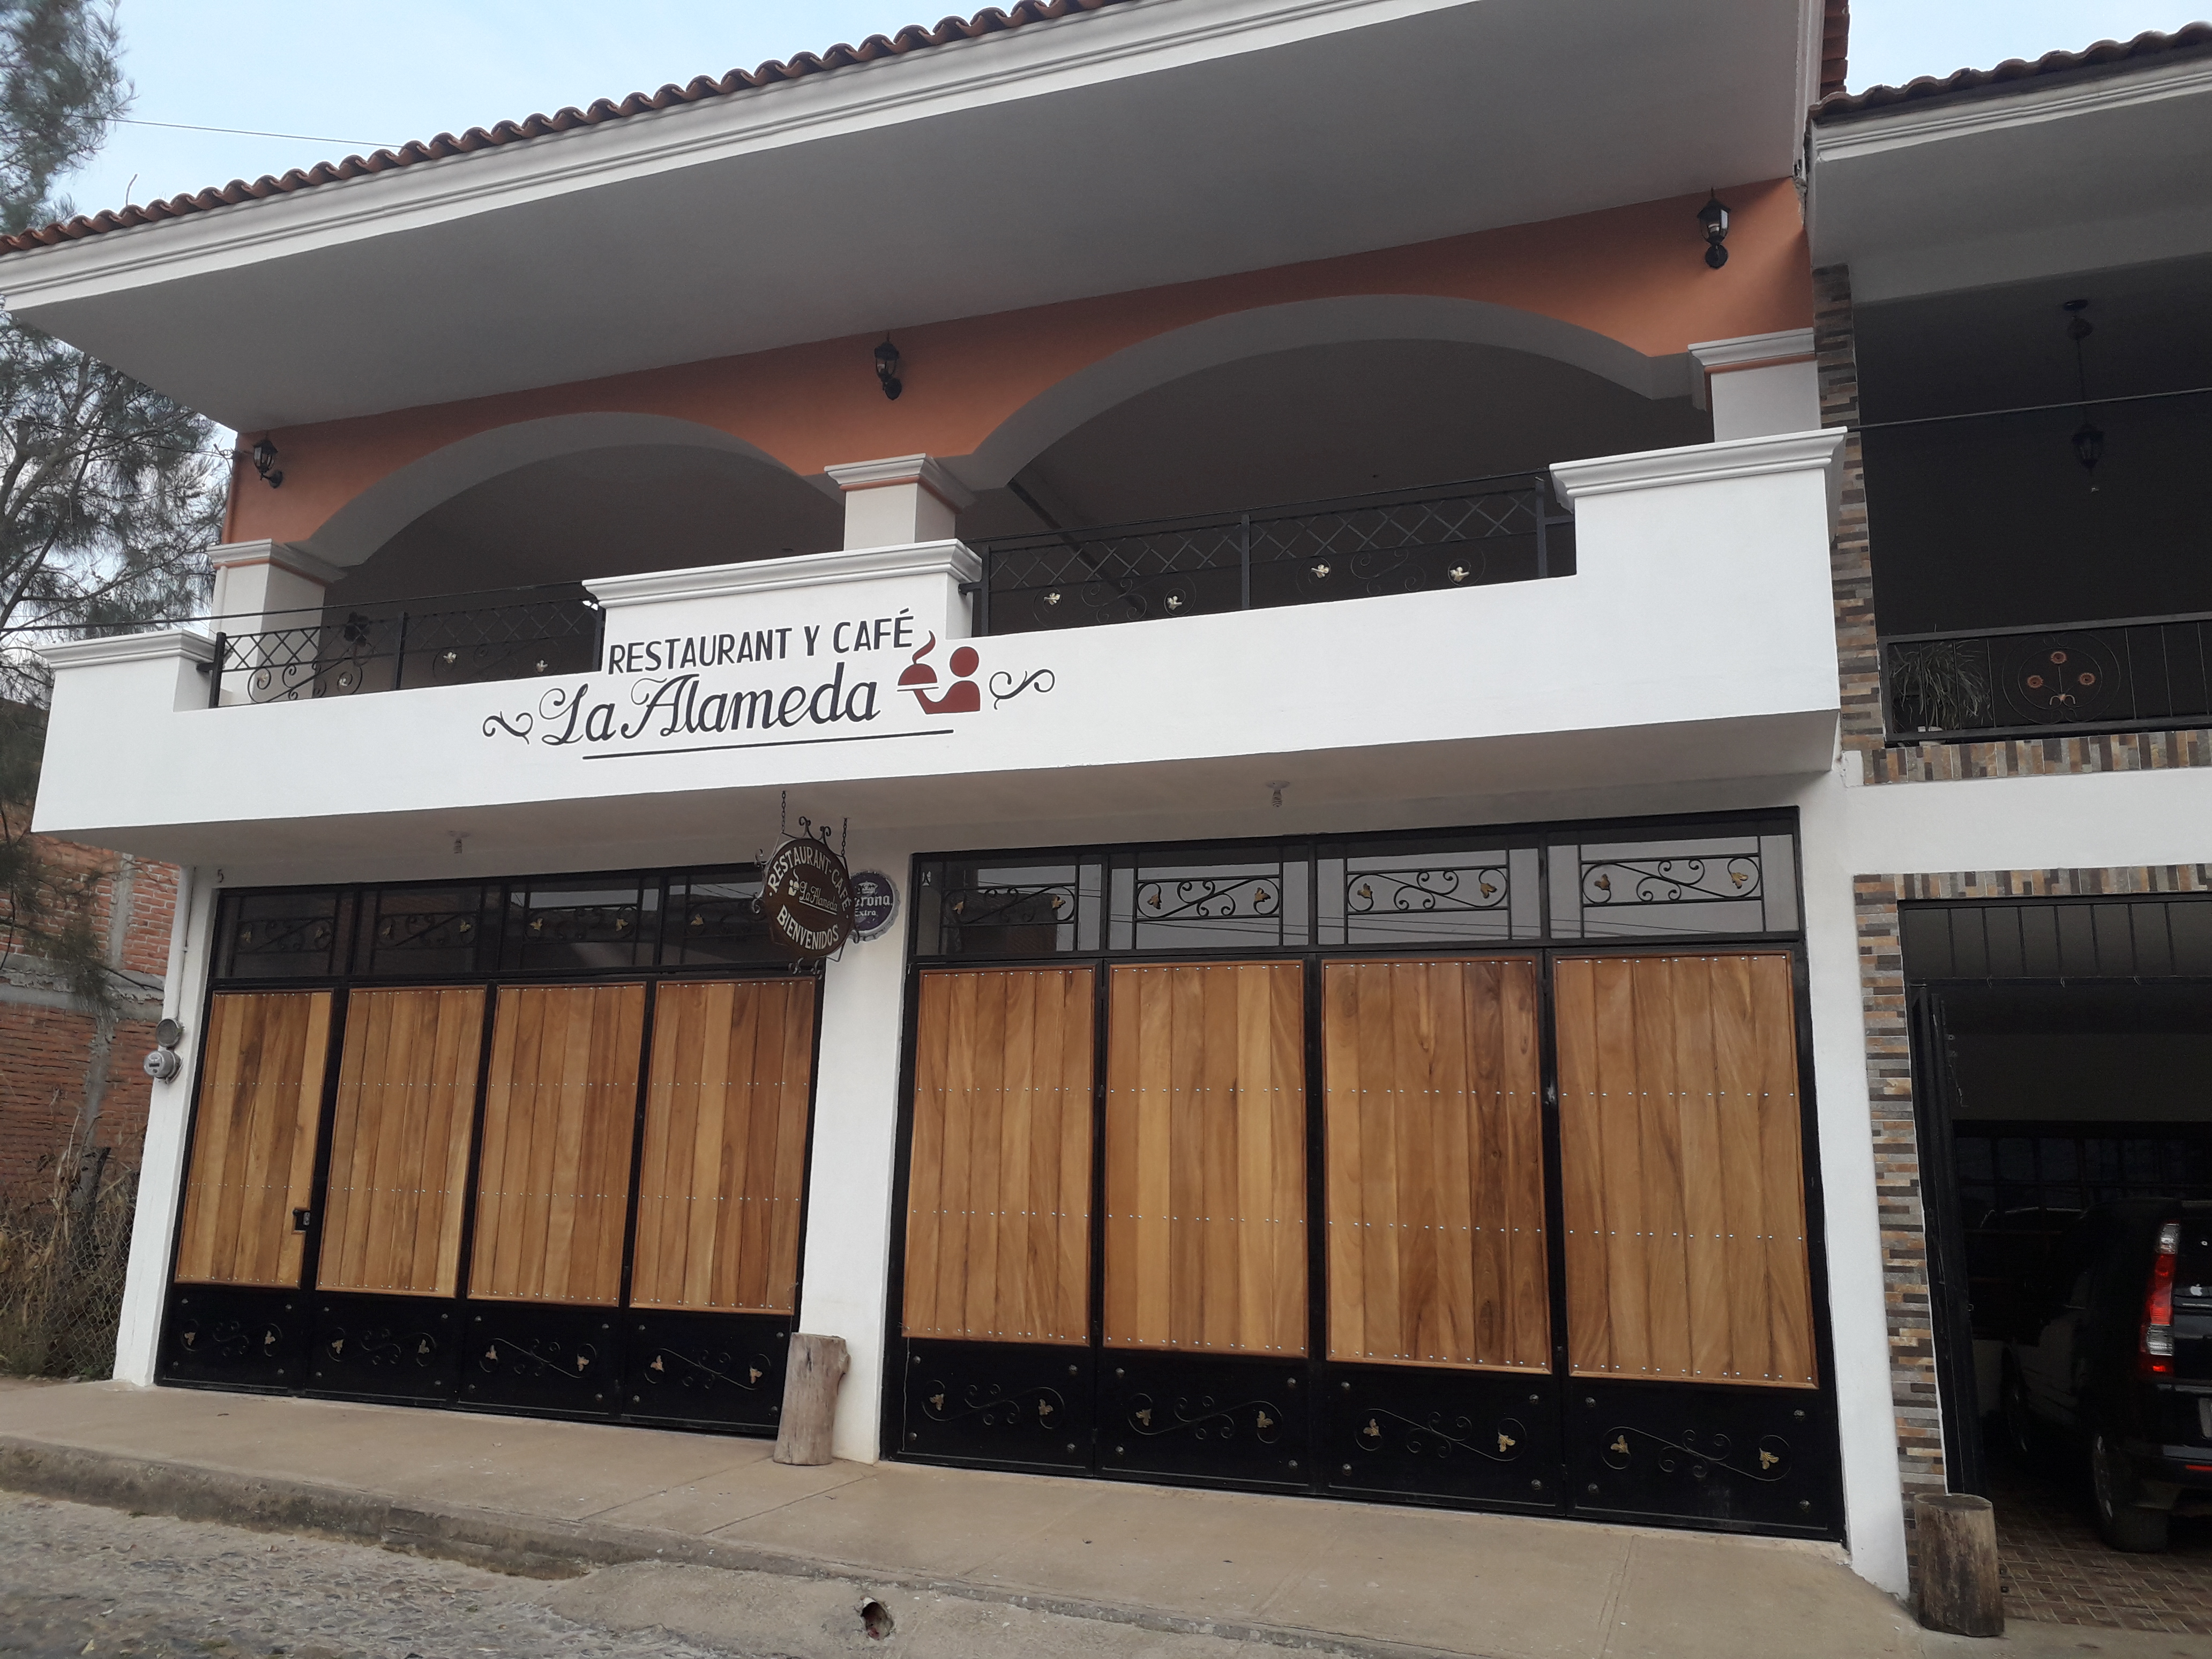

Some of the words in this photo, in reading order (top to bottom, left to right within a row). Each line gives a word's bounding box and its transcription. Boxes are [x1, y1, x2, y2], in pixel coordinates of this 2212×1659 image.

[608, 627, 792, 675] RESTAURANT
[804, 625, 820, 656] Y
[833, 608, 914, 653] CAFÉ
[539, 683, 616, 746] La
[621, 661, 881, 739] Alameda
[810, 886, 838, 911] Alameda
[854, 895, 891, 908] orona
[855, 908, 877, 917] Extra
[776, 904, 839, 950] BIENVENIDOS
